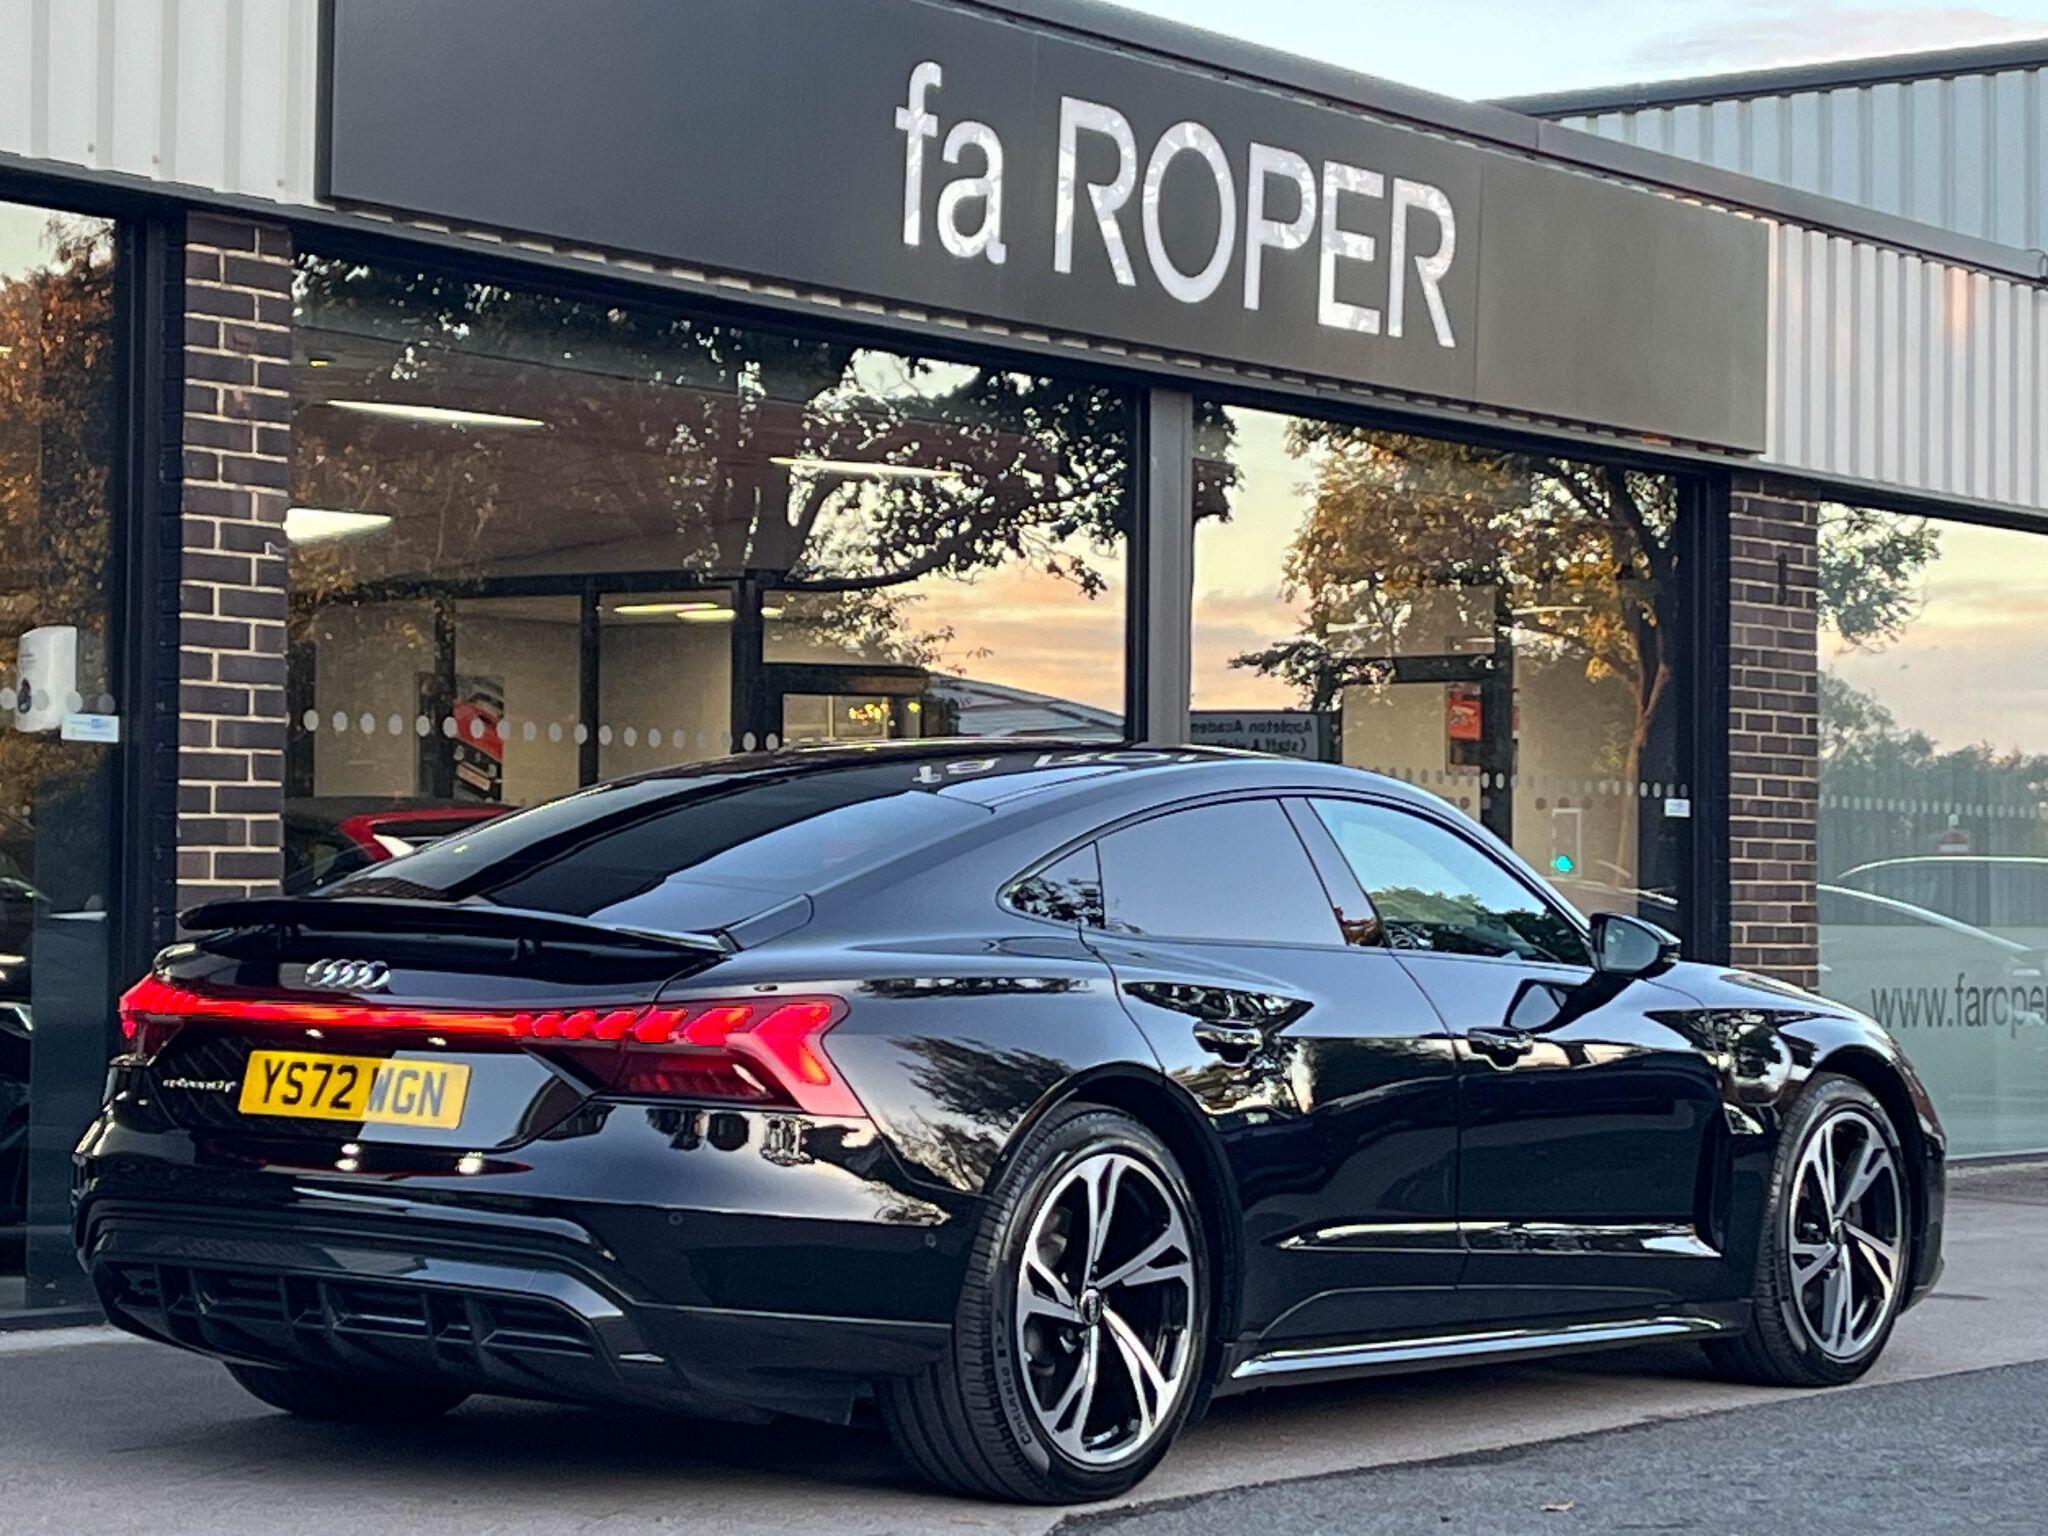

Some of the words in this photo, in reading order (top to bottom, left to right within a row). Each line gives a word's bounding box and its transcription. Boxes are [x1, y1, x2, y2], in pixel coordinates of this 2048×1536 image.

[895, 61, 1006, 265] fa
[1054, 96, 1456, 348] ROPER
[1871, 971, 2048, 1039] www.farope
[261, 1058, 358, 1110] YS72
[368, 1066, 446, 1118] WGN
